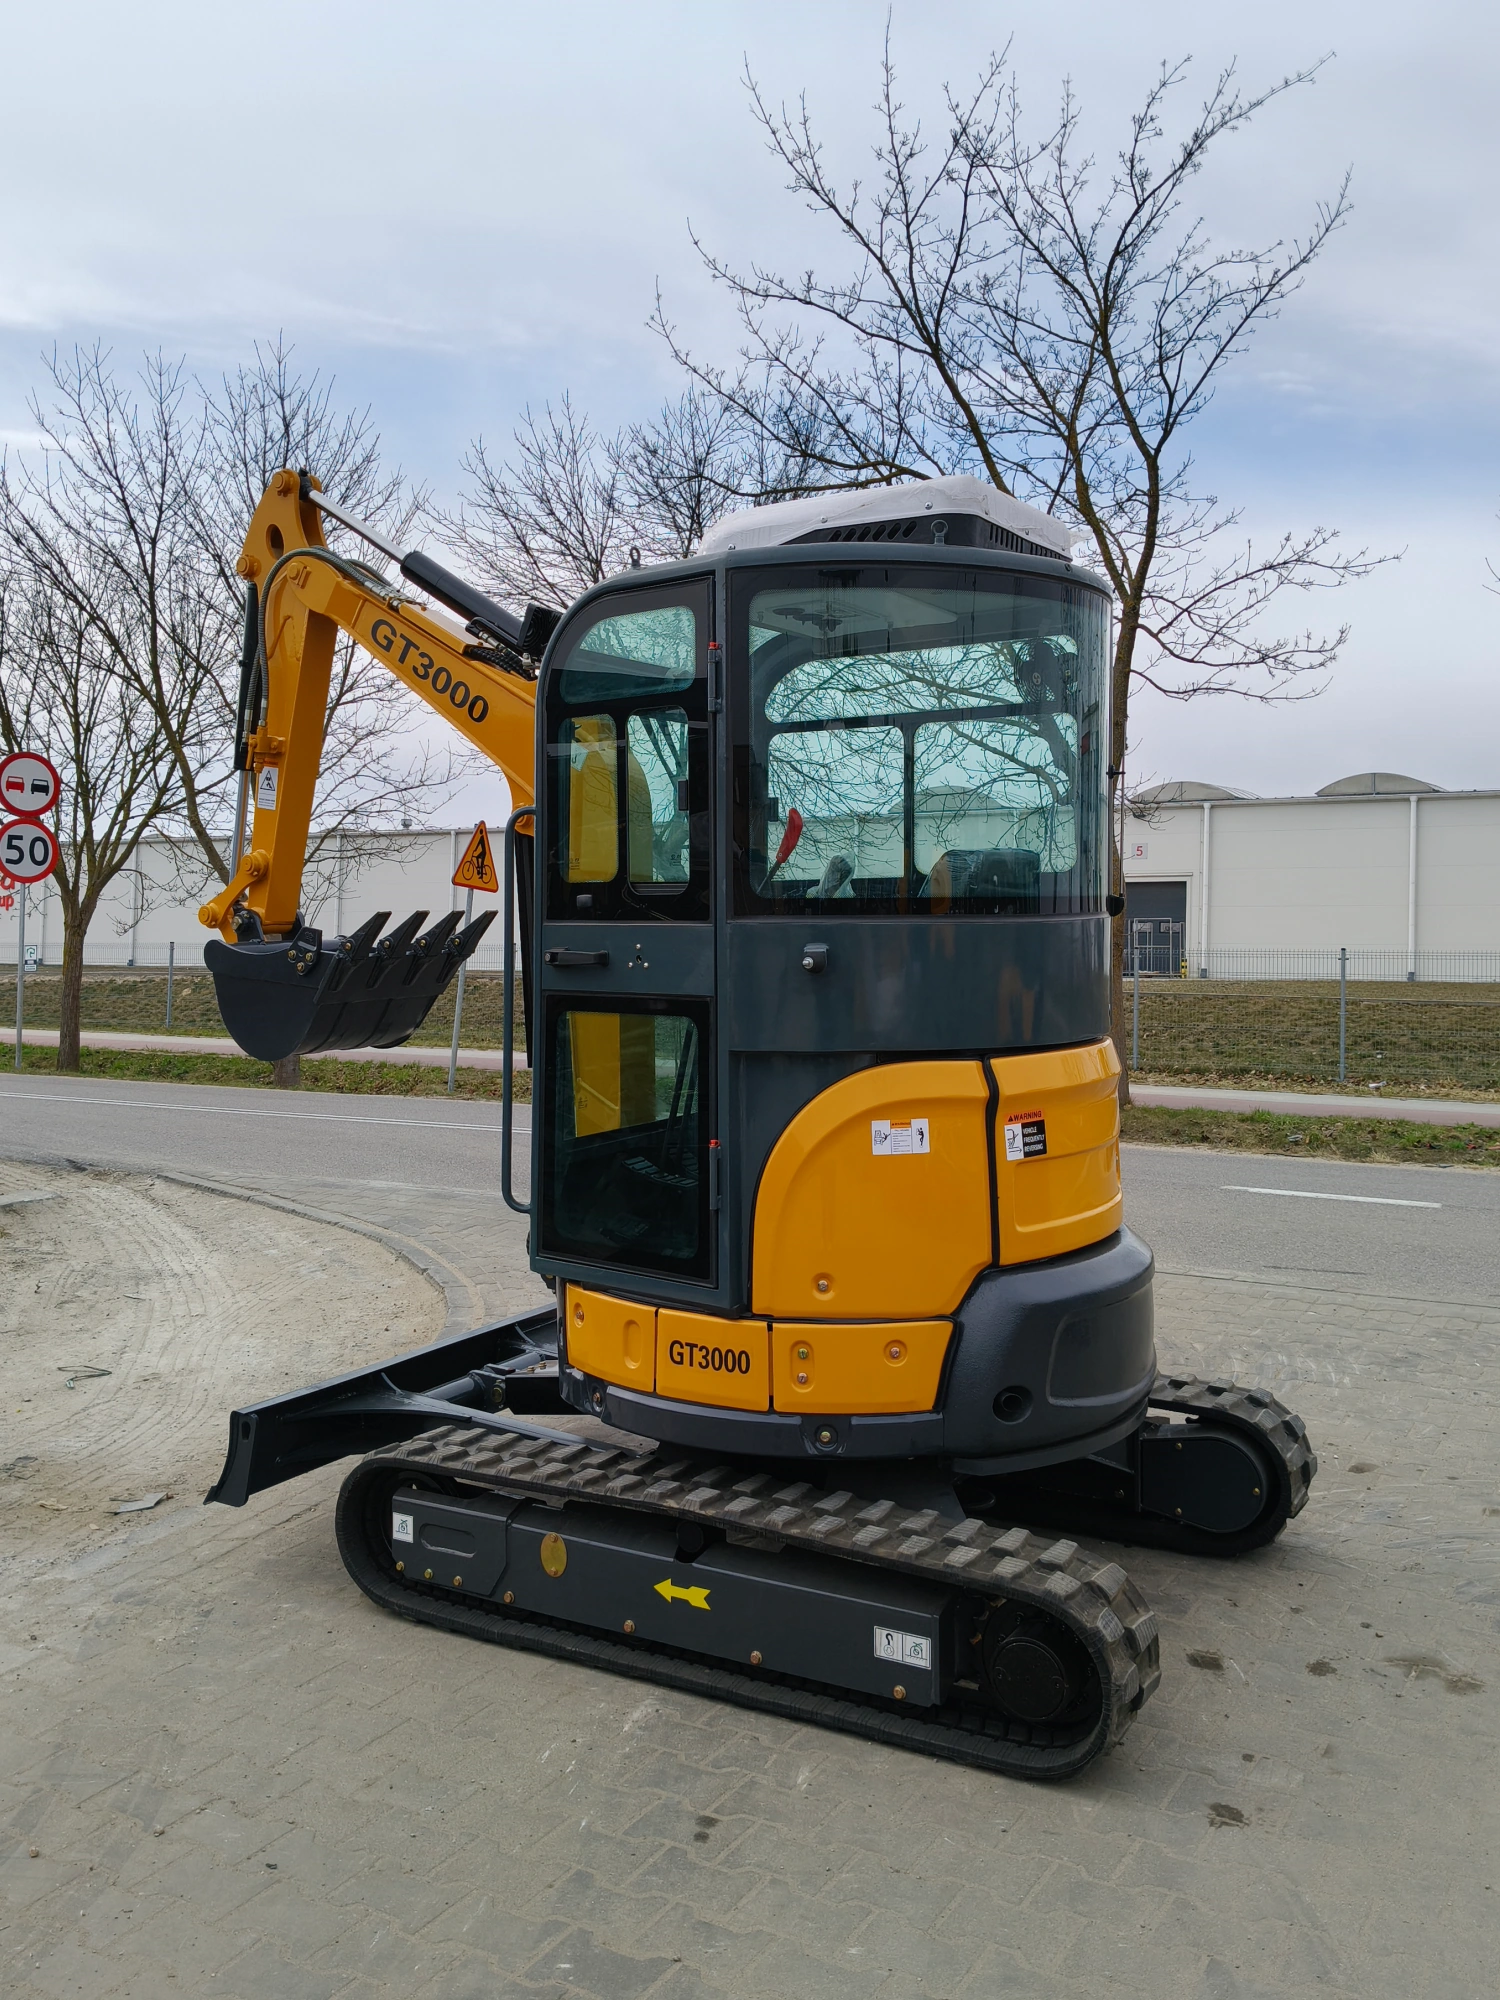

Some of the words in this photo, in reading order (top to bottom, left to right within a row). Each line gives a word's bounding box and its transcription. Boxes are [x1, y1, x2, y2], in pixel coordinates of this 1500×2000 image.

[371, 618, 489, 723] GT3000
[5, 834, 49, 866] 50
[1136, 845, 1143, 857] 5
[1014, 1110, 1042, 1121] WARNING
[1023, 1126, 1037, 1134] VEHICLE
[1024, 1134, 1045, 1143] FREQUENTLY
[1025, 1143, 1044, 1152] REVERSING
[669, 1339, 751, 1375] GT3000
